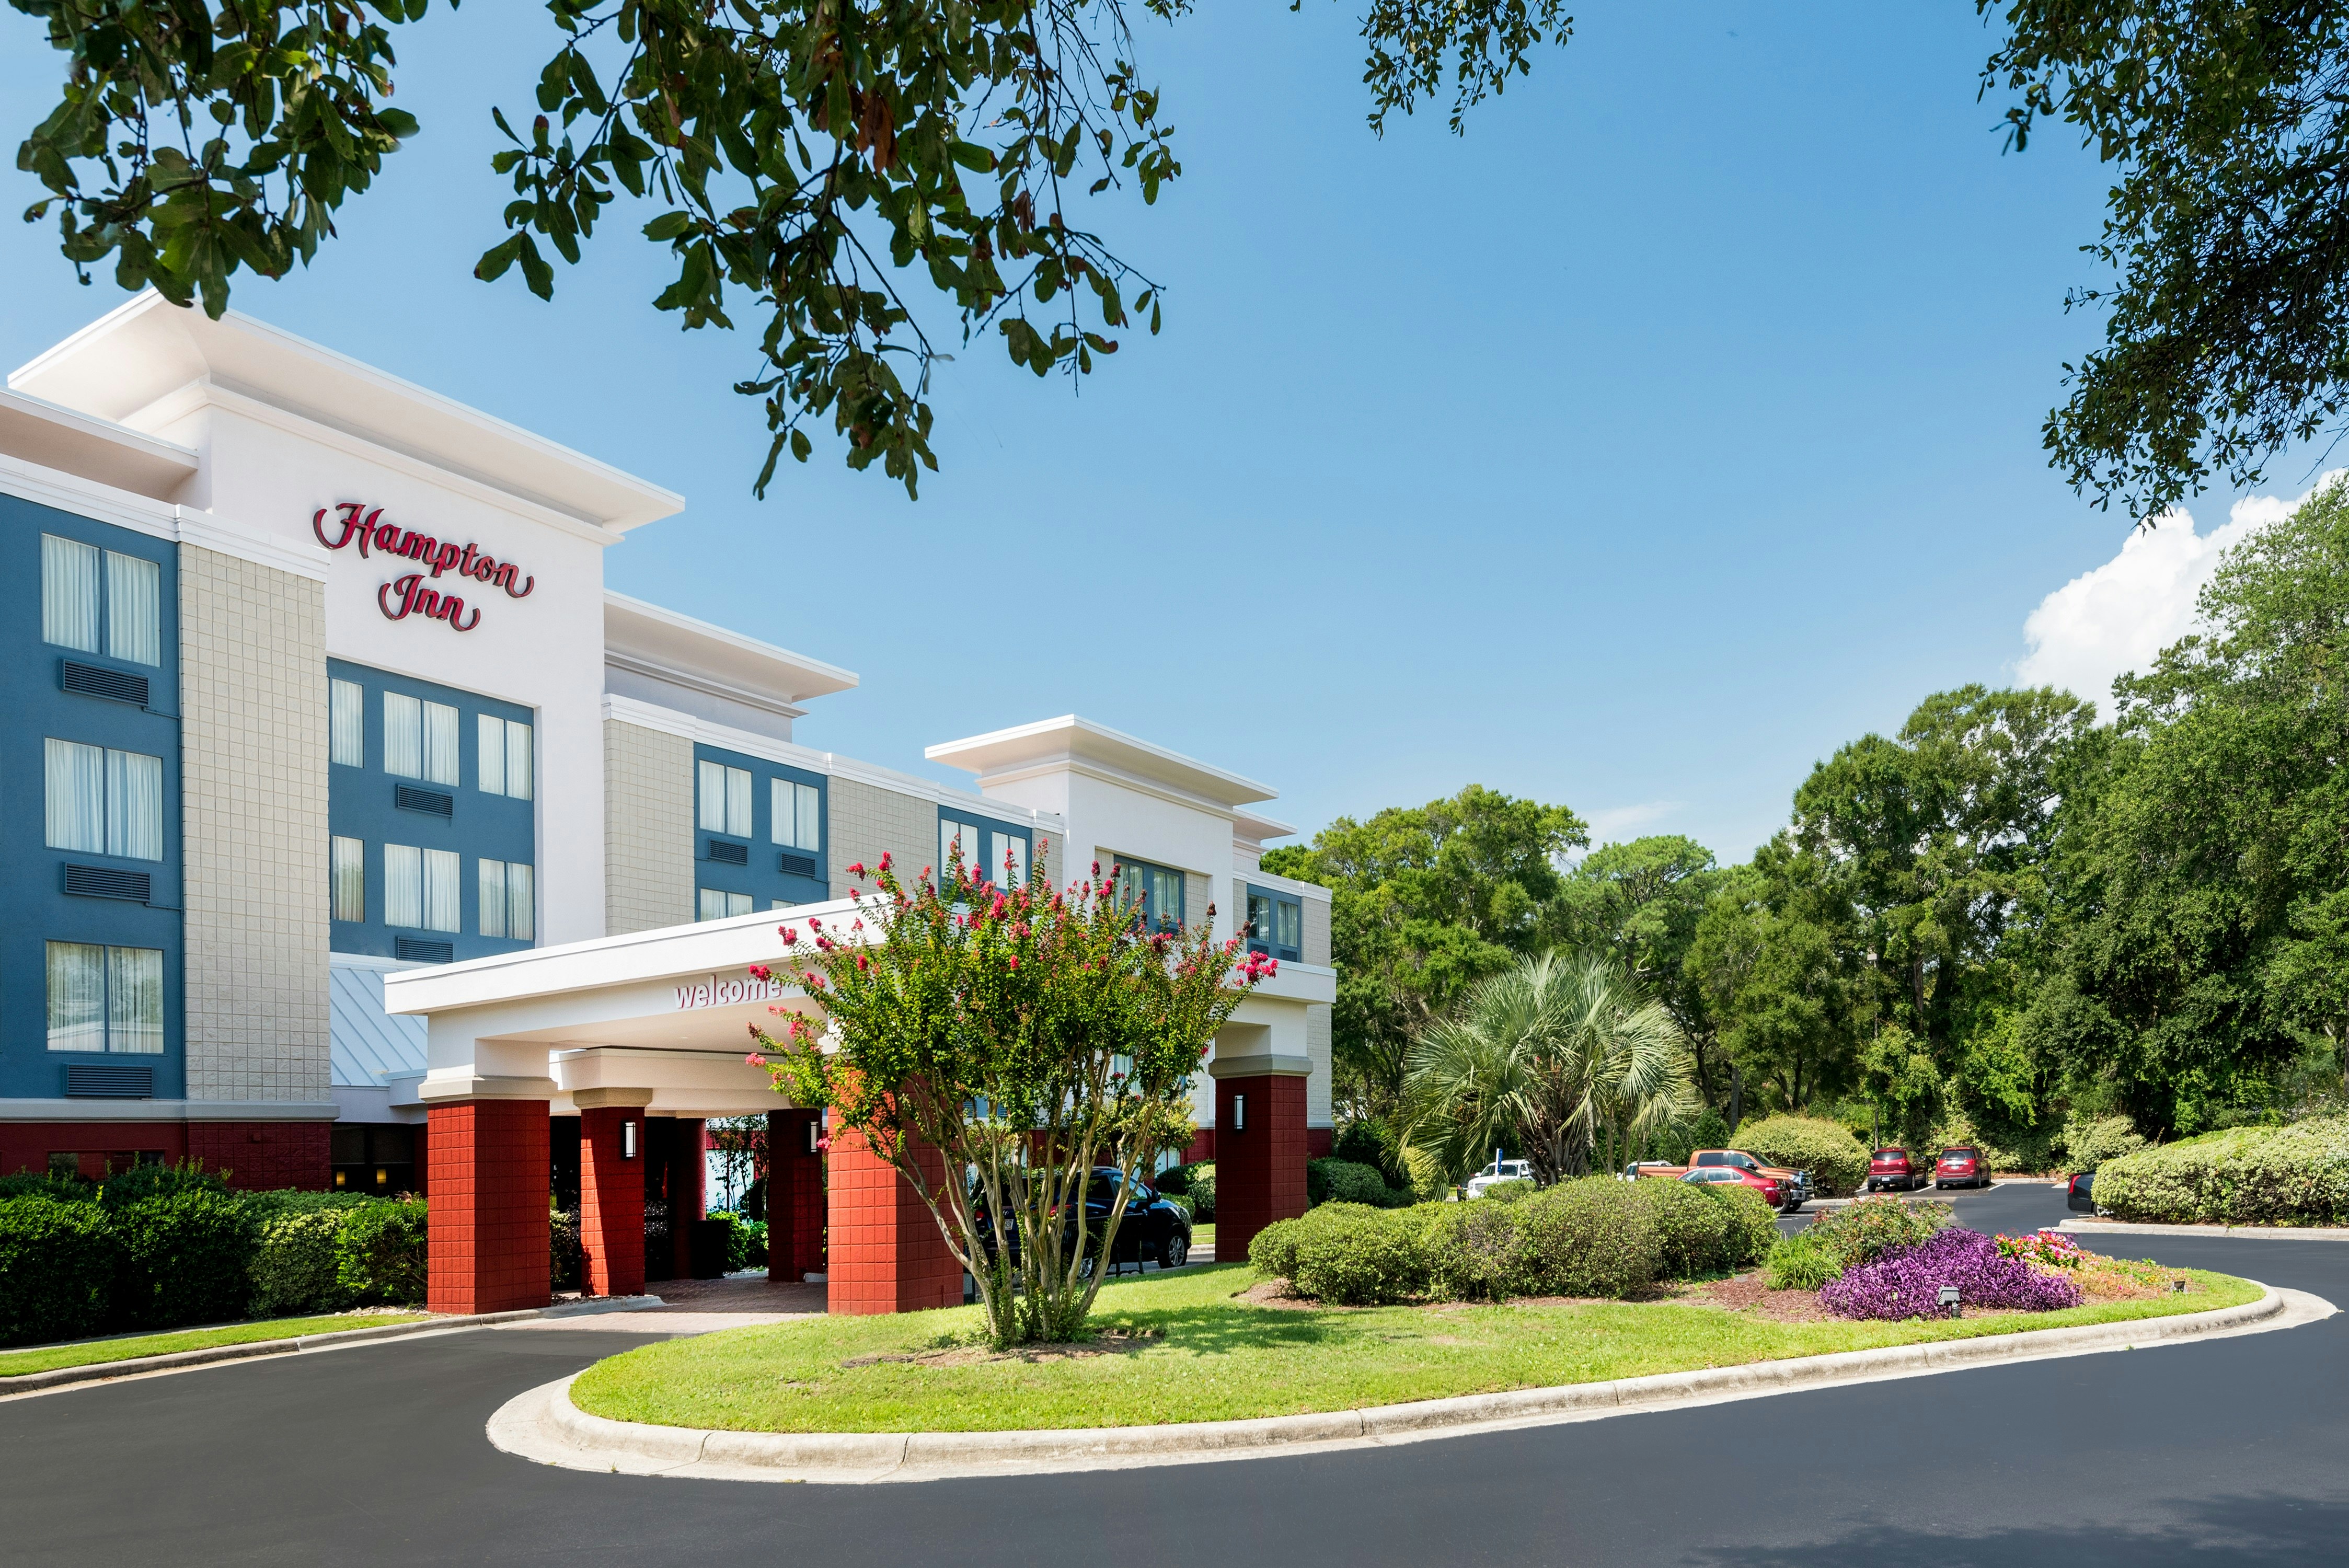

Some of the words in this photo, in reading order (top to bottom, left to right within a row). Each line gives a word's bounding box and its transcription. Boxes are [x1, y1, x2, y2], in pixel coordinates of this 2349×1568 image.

[314, 502, 534, 598] Hampton
[378, 574, 481, 632] Inn
[673, 974, 782, 1008] welcome
